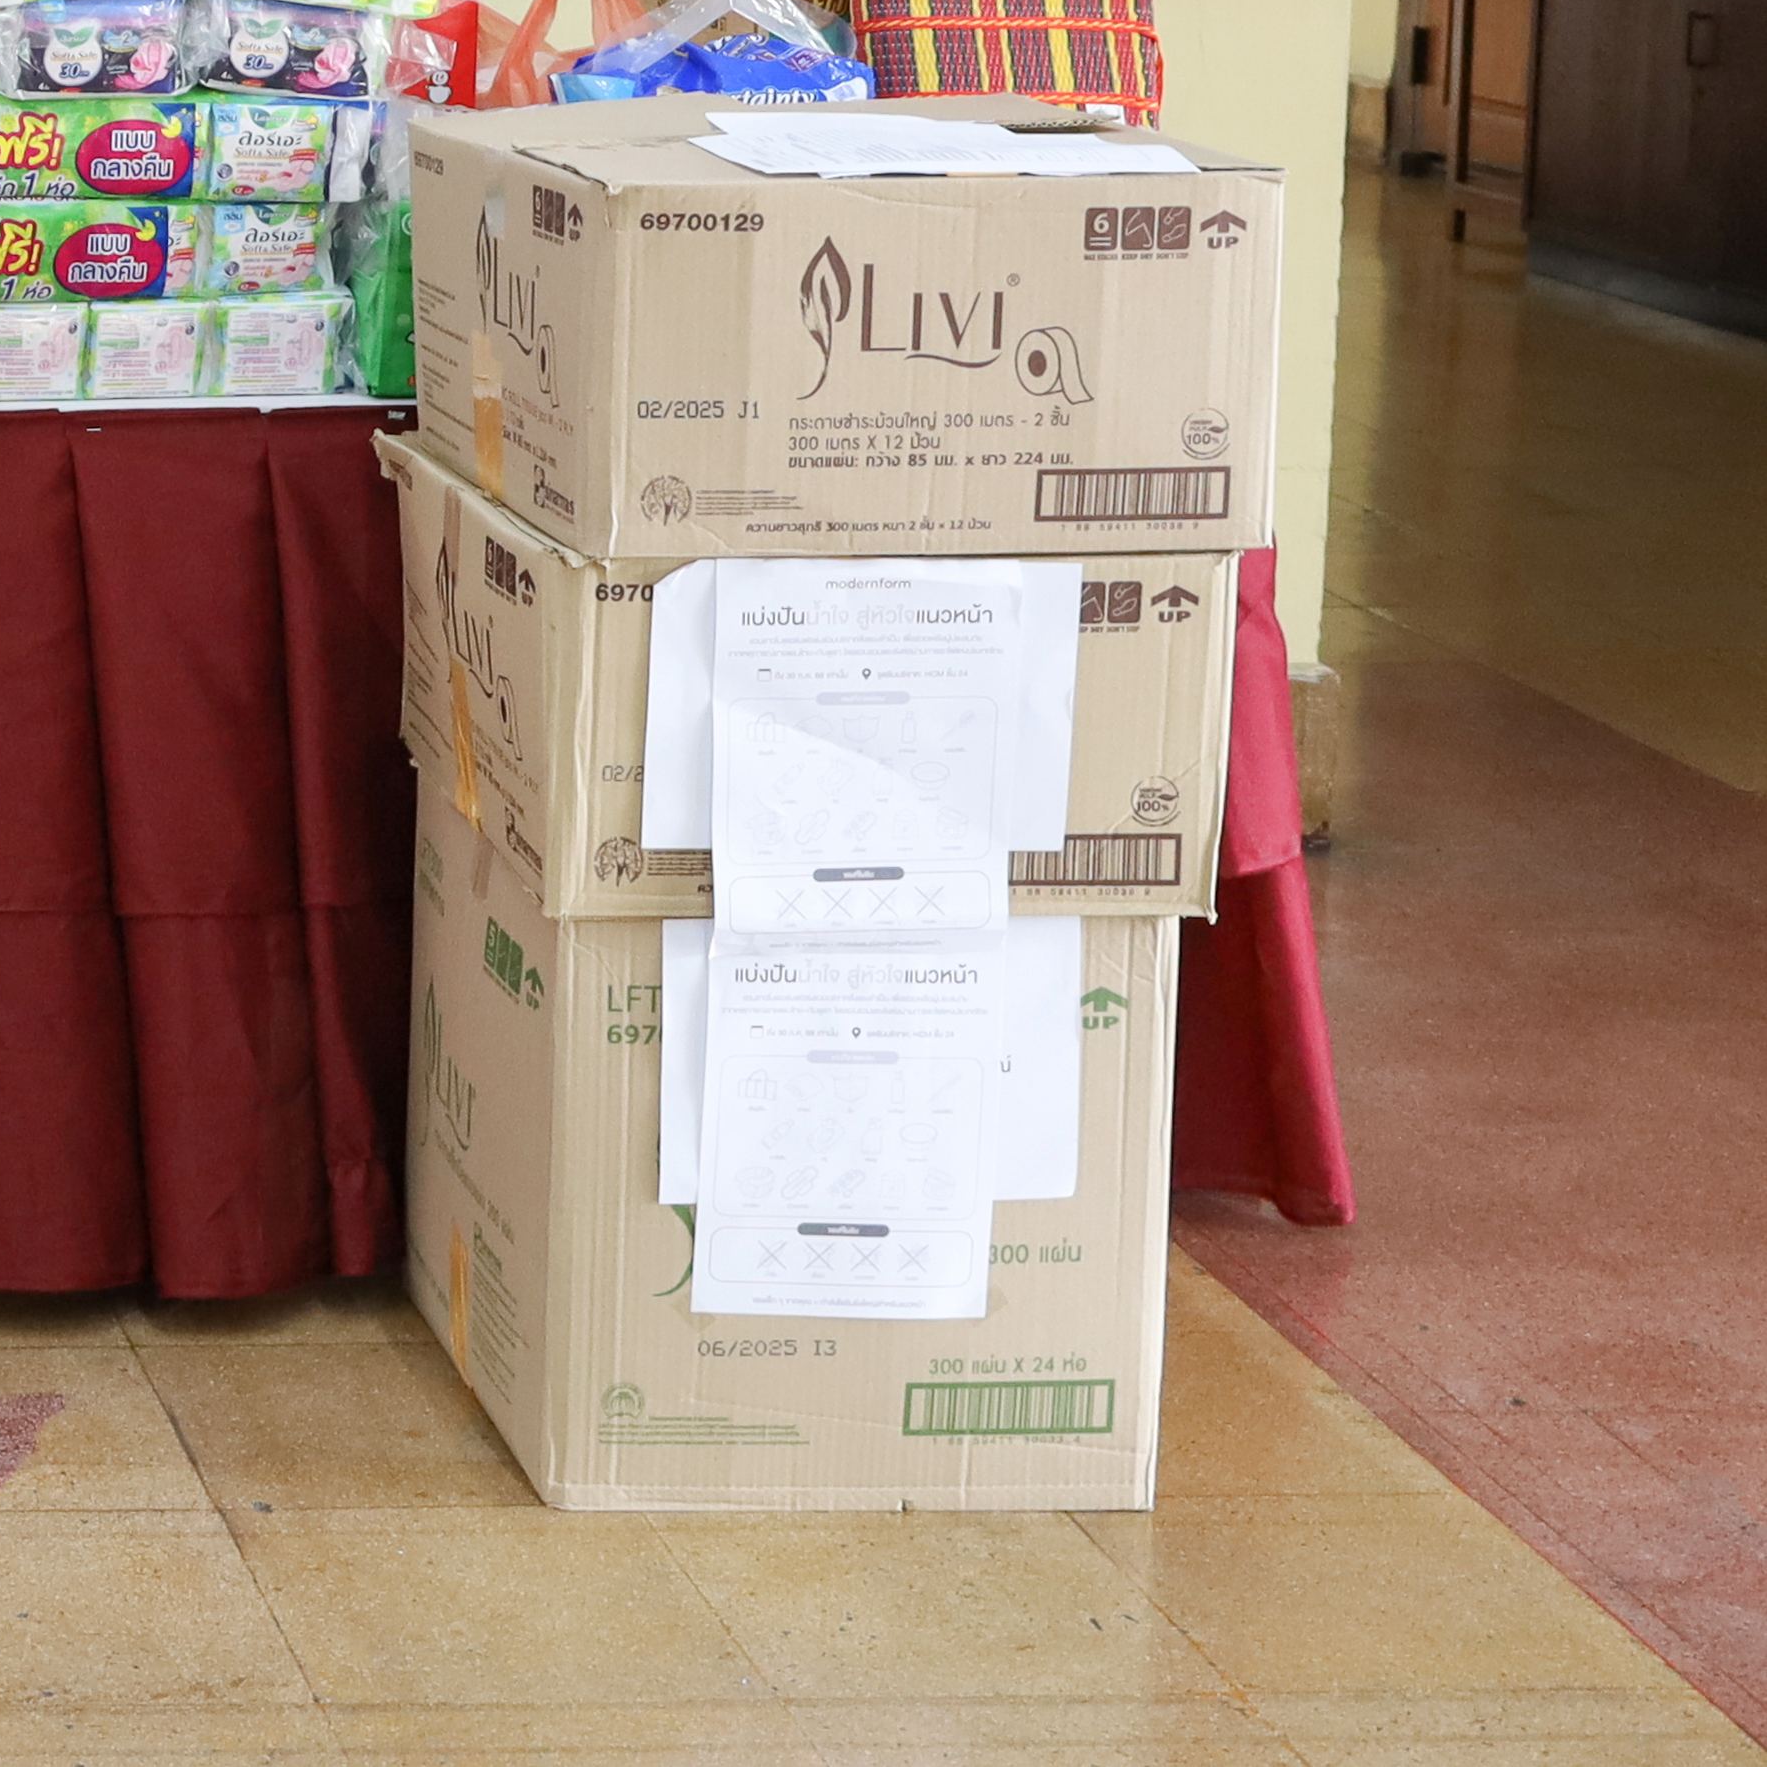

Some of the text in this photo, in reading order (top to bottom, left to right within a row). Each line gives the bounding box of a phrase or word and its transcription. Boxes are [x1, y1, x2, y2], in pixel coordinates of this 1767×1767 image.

[59, 65, 79, 78] 30
[111, 129, 156, 151] แบบ
[91, 151, 174, 181] กลางคืน
[24, 176, 39, 197] 1
[640, 213, 764, 232] 69700129
[1093, 213, 1109, 233] 6
[1207, 237, 1239, 249] UP
[637, 401, 760, 419] 02/2025 J1
[944, 414, 973, 428] 300
[980, 414, 1014, 428] เมตร
[1035, 414, 1043, 427] 2
[788, 436, 818, 451] 300
[826, 437, 860, 450] เมตร
[885, 436, 903, 450] 12
[866, 451, 901, 468] กว้าง
[908, 454, 927, 467] 85
[1015, 453, 1043, 465] 224
[825, 577, 911, 590] modernform
[742, 600, 850, 627] แบ่งปันน้ำใจ
[1158, 611, 1191, 623] UP
